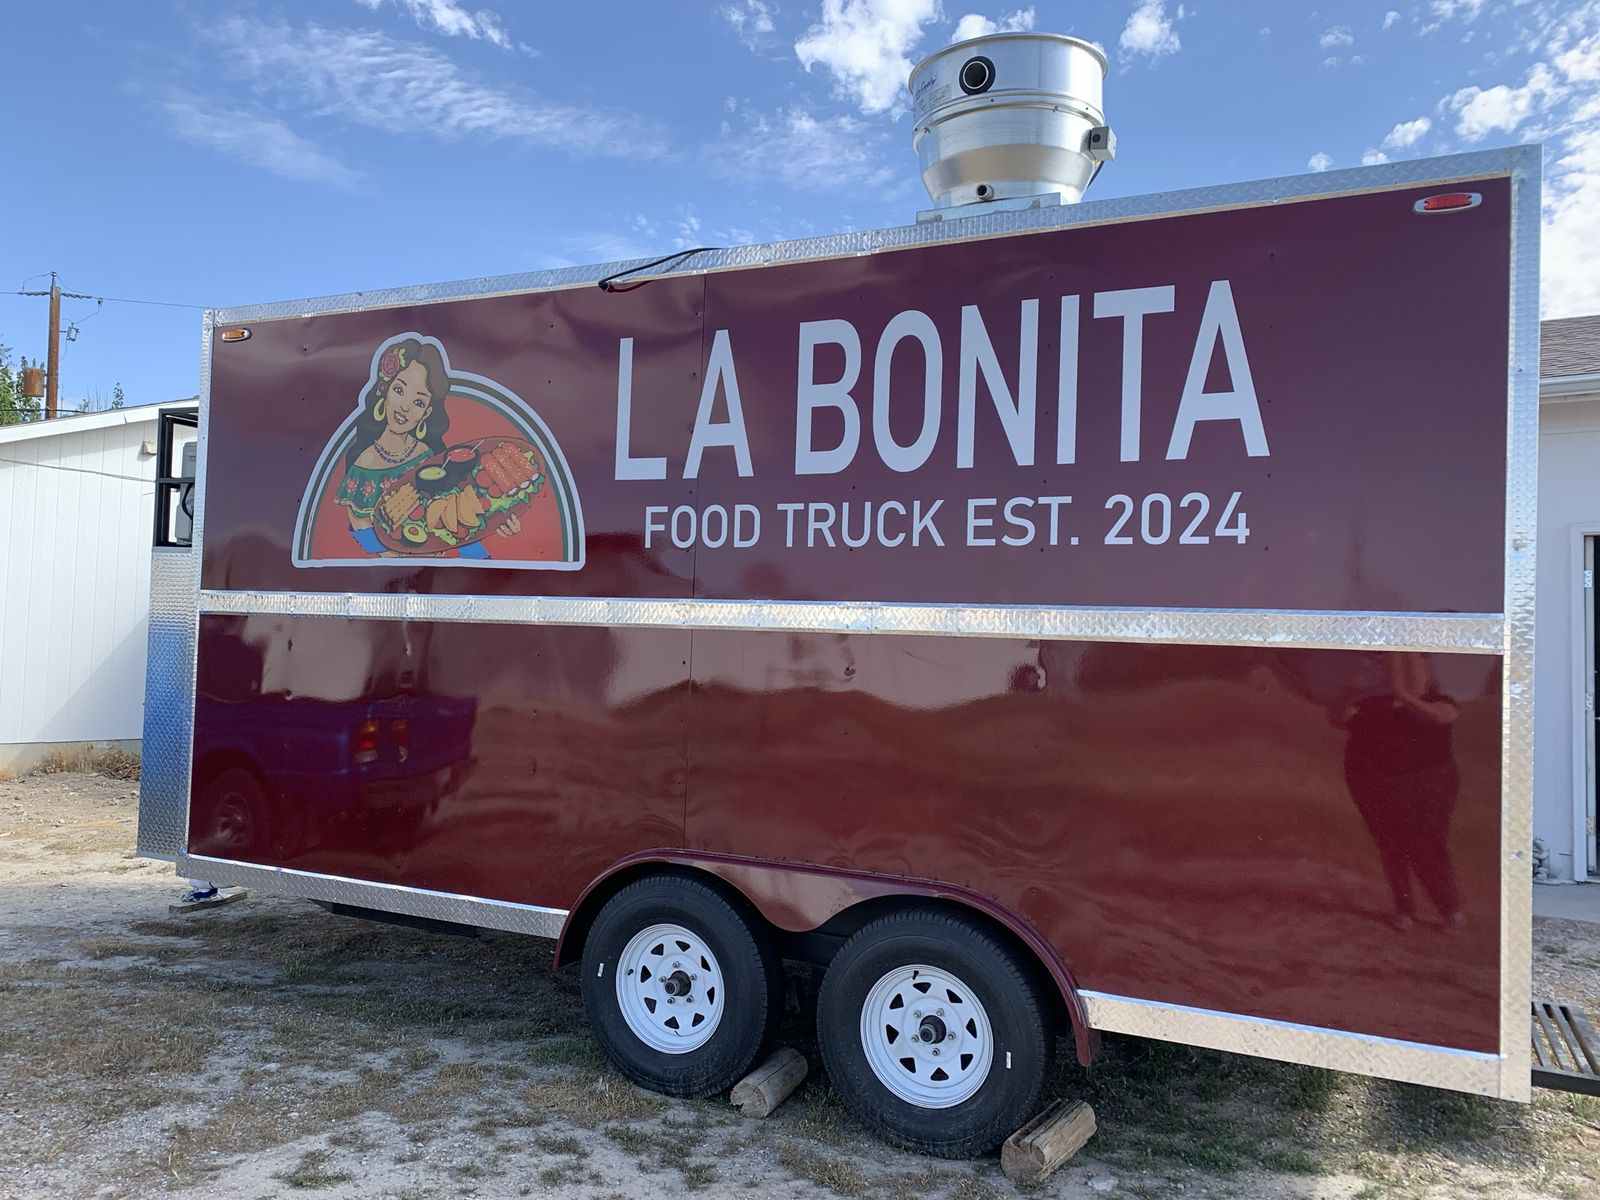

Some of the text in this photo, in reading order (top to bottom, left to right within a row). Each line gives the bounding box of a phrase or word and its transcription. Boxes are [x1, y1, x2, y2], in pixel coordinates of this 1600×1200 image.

[614, 280, 1271, 481] LA BONITA
[644, 491, 1251, 549] FOOD TRUCK EST. 2024
